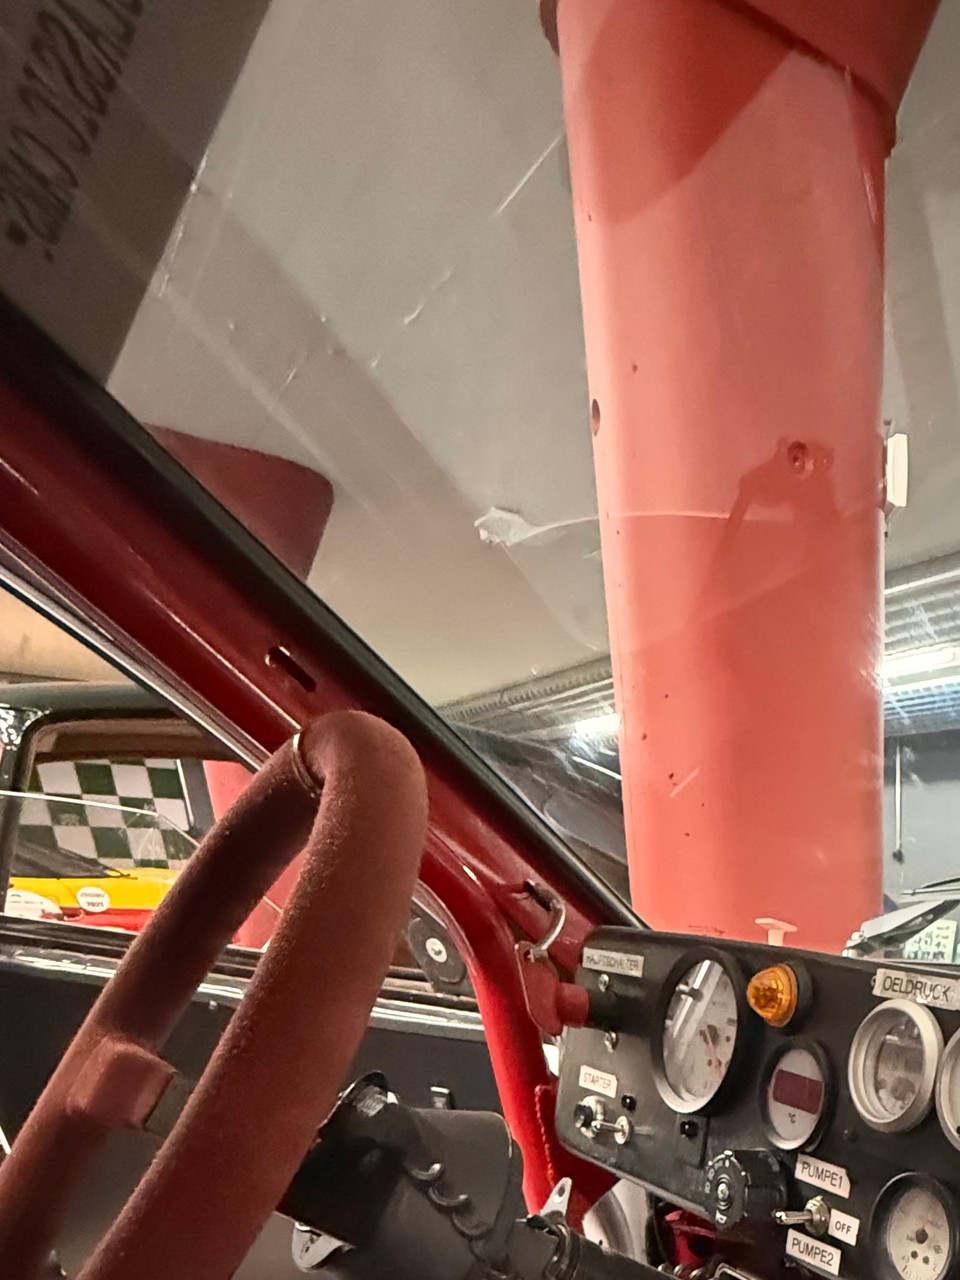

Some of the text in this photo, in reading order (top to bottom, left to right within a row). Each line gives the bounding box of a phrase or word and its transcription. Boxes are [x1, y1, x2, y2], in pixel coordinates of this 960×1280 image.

[882, 975, 950, 1003] OELDRUCK
[801, 1161, 843, 1190] PUMPE1
[834, 1219, 853, 1236] OFF
[791, 1237, 835, 1267] PUMPE2
